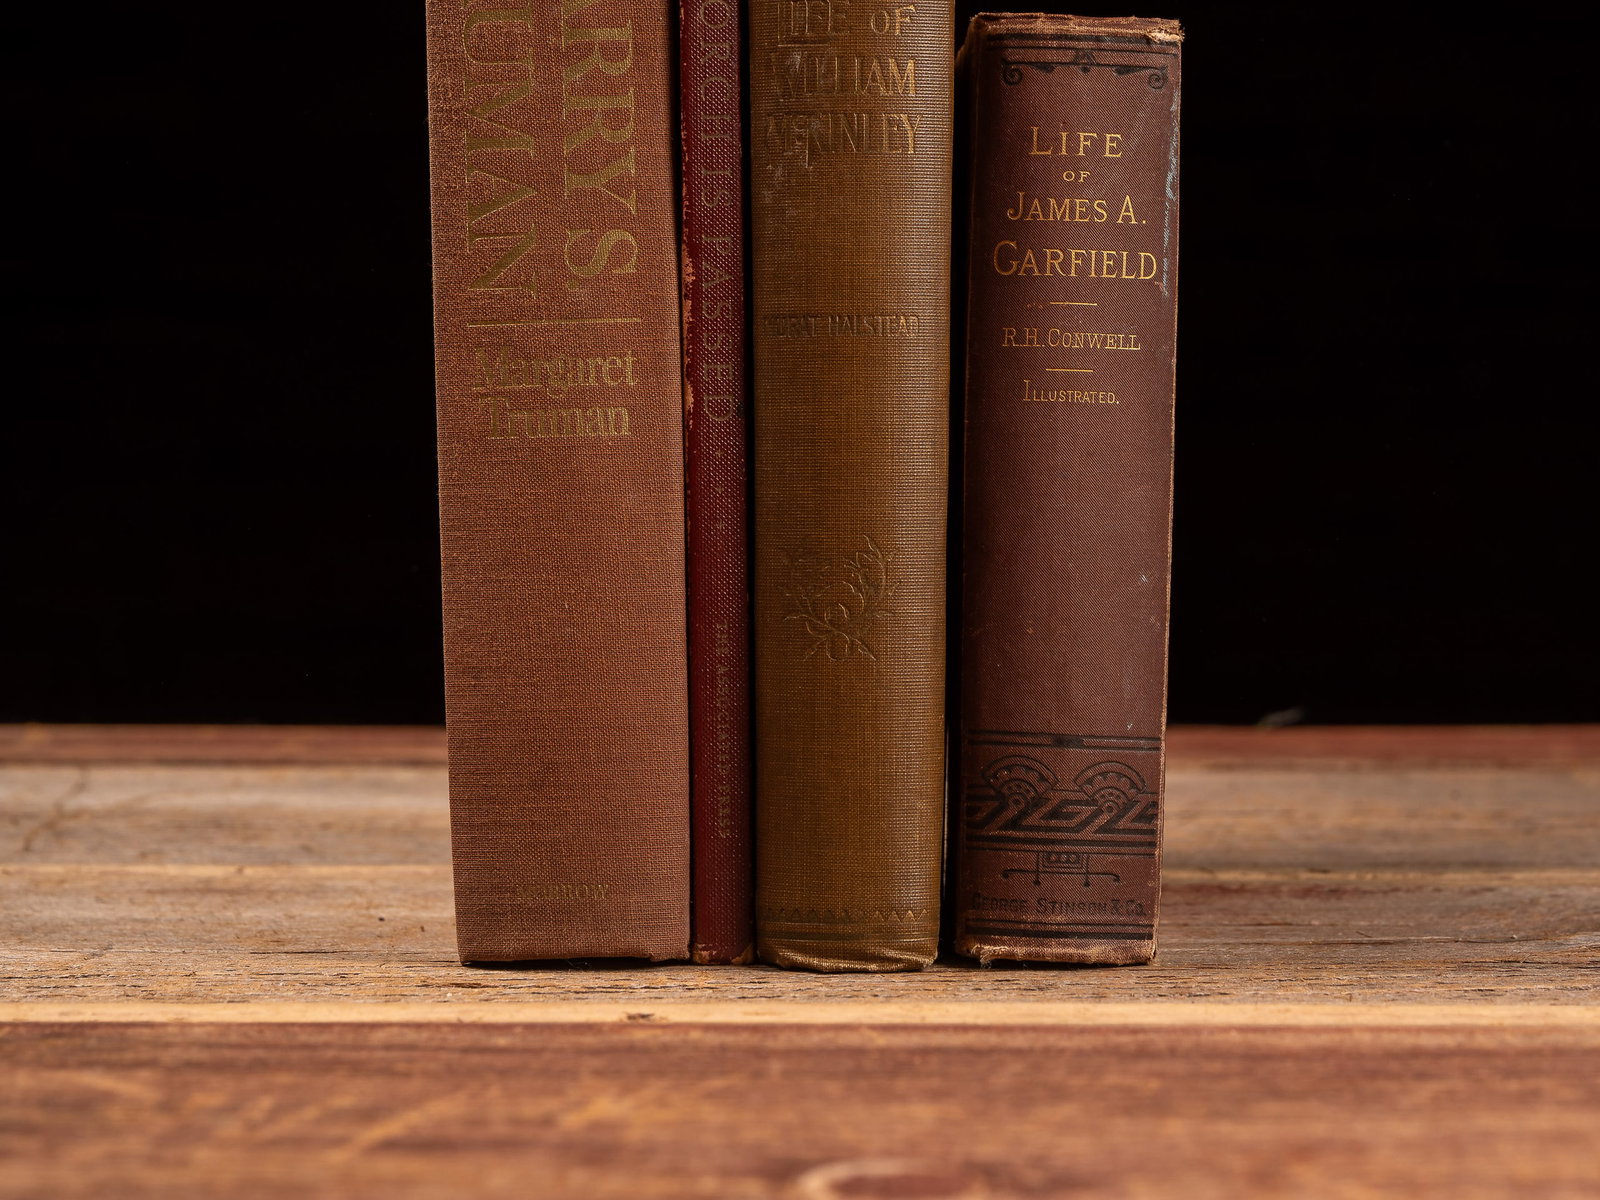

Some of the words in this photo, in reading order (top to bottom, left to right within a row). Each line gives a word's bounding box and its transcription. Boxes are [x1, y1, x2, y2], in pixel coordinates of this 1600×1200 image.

[870, 4, 917, 38] OF
[1029, 126, 1123, 158] LIFE
[700, 166, 733, 208] IS
[1062, 170, 1091, 182] OF
[1007, 191, 1107, 223] JAMES
[1116, 194, 1147, 225] A.
[993, 239, 1158, 281] GARFIELD
[701, 235, 735, 422] PASSED
[472, 346, 639, 398] Margaret
[479, 396, 631, 439] Truman
[716, 620, 730, 655] THE
[717, 664, 731, 776] ASSOCIATED
[717, 785, 732, 839] PRESS
[1036, 897, 1107, 915] STINSON
